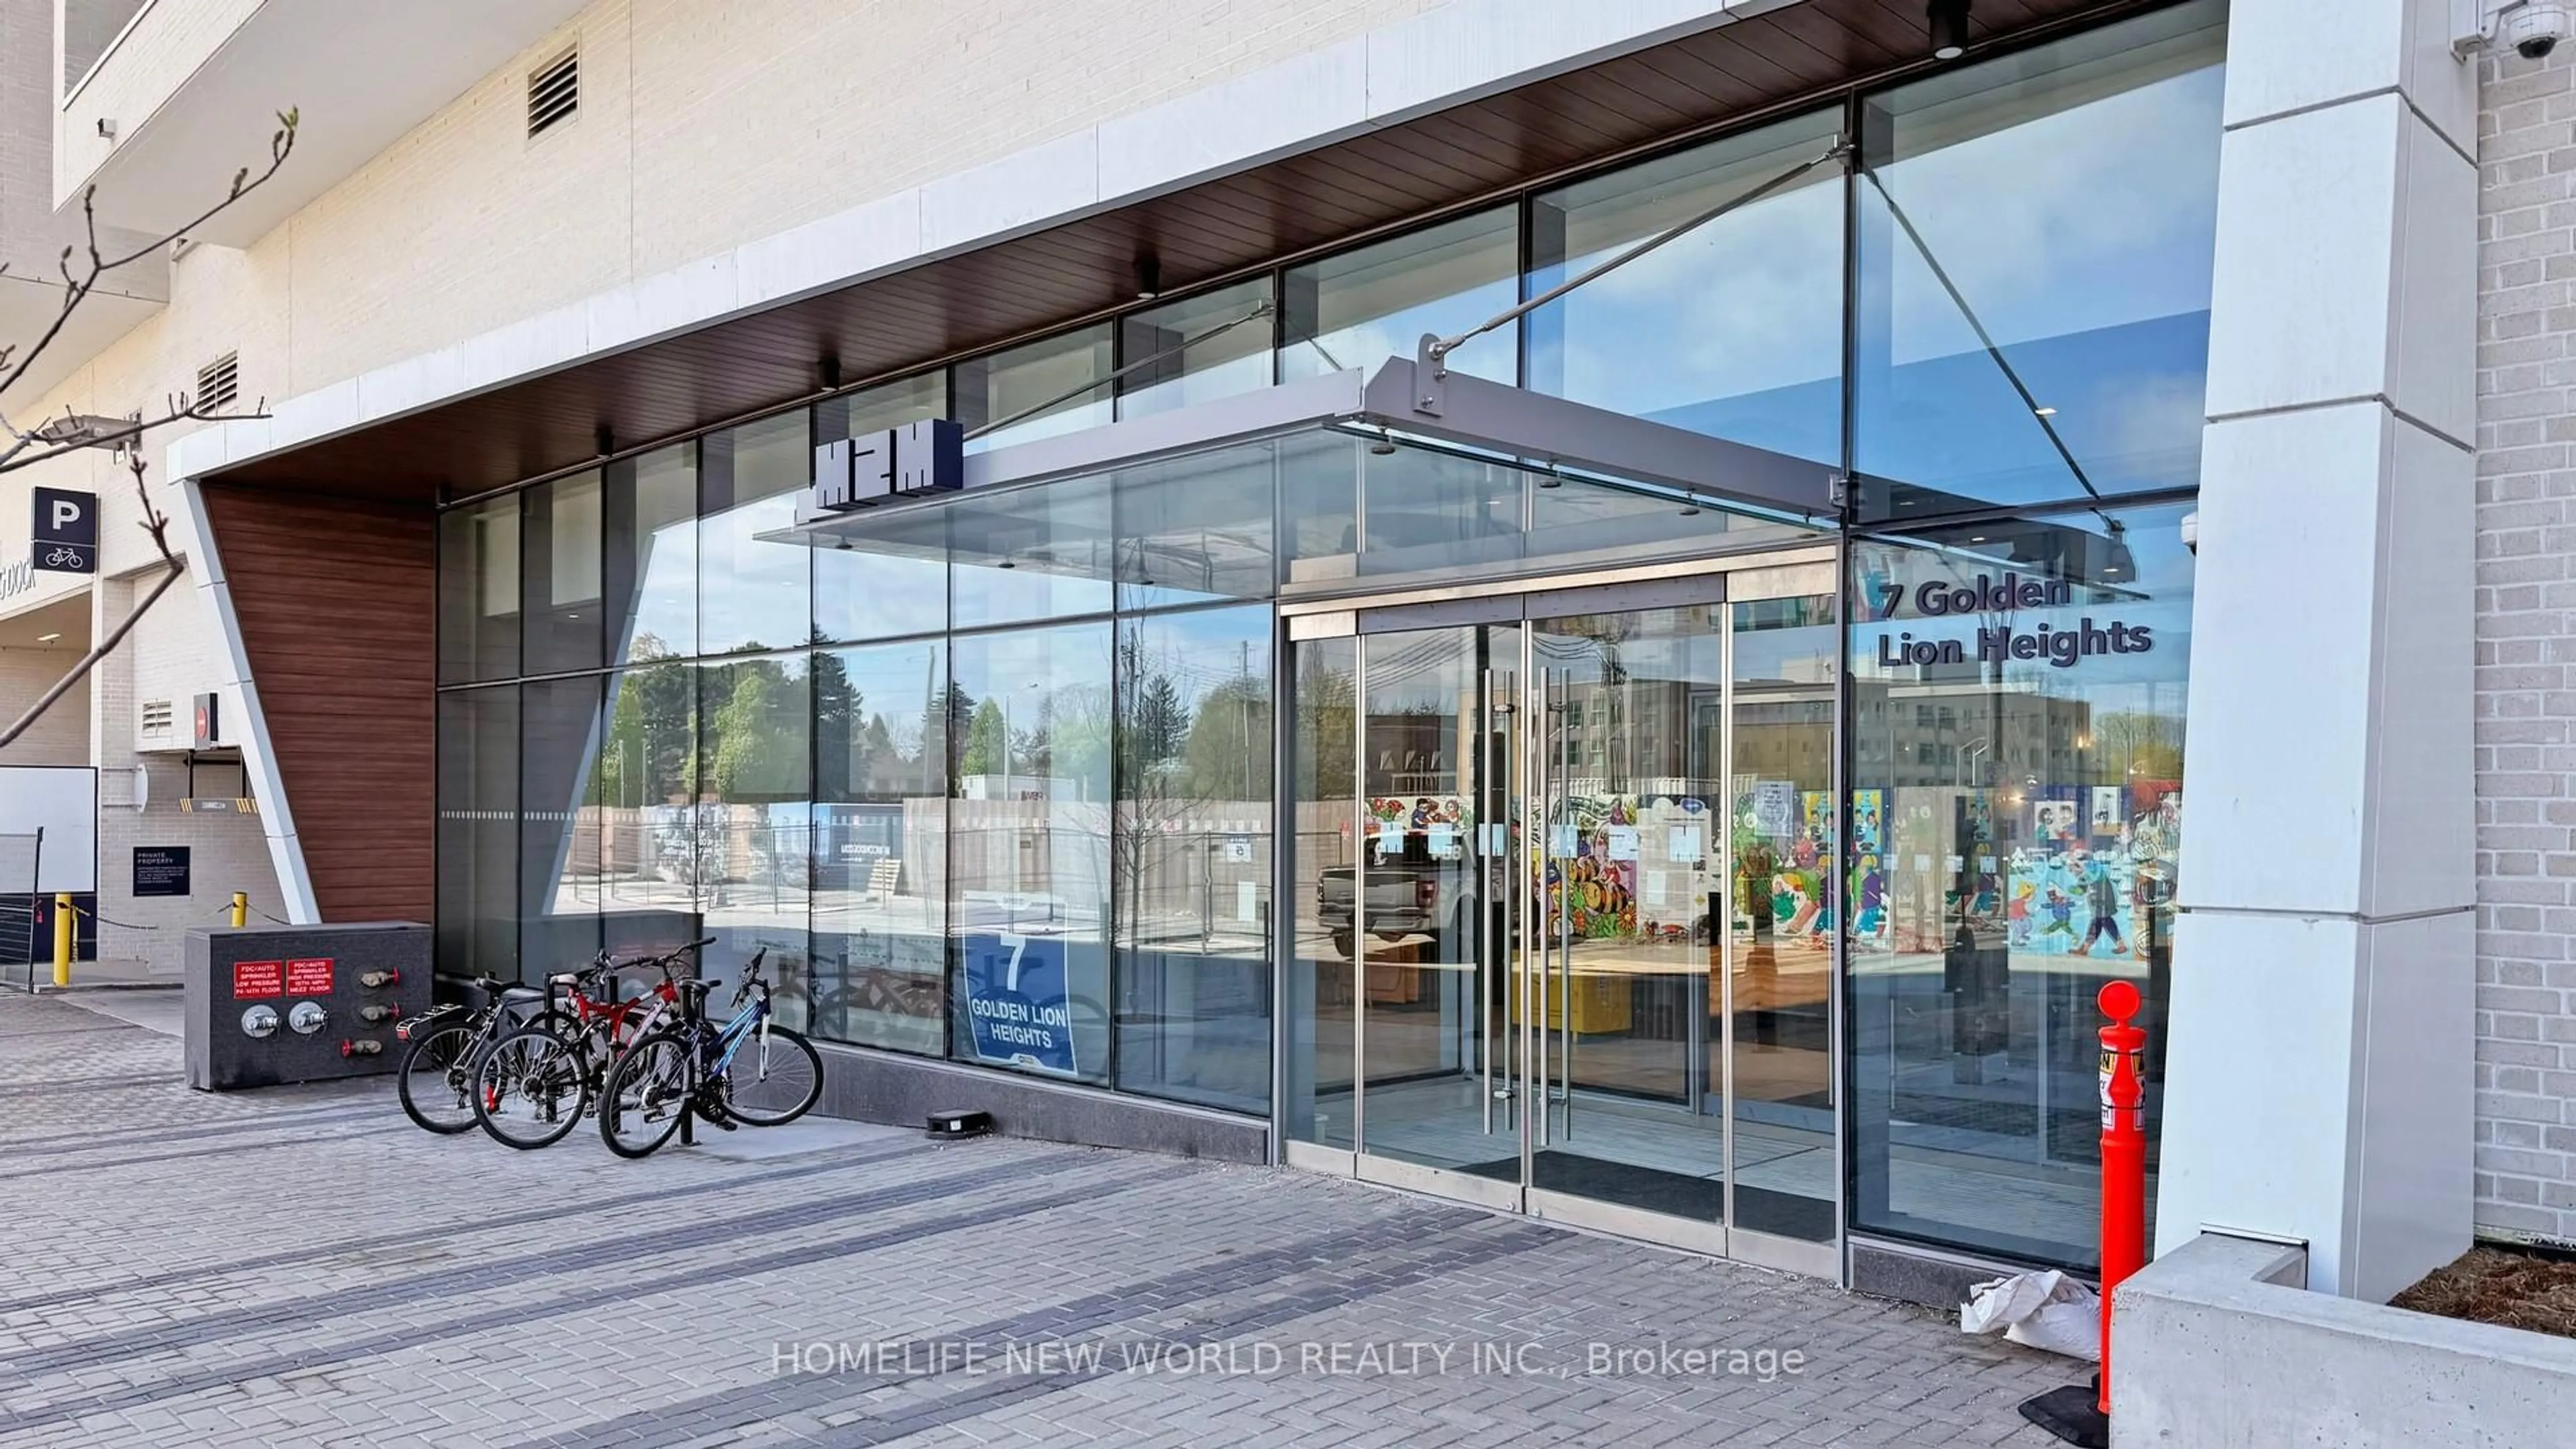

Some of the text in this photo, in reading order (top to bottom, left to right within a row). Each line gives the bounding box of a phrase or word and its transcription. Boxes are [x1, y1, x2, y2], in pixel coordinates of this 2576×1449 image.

[816, 419, 934, 508] M2M
[52, 500, 80, 530] P
[1878, 572, 2071, 619] 7 Golden
[1879, 618, 2152, 668] Lion Heights
[1000, 932, 1026, 991] 7
[972, 998, 1067, 1027] GOLDEN LION
[990, 1023, 1053, 1049] HEIGHTS
